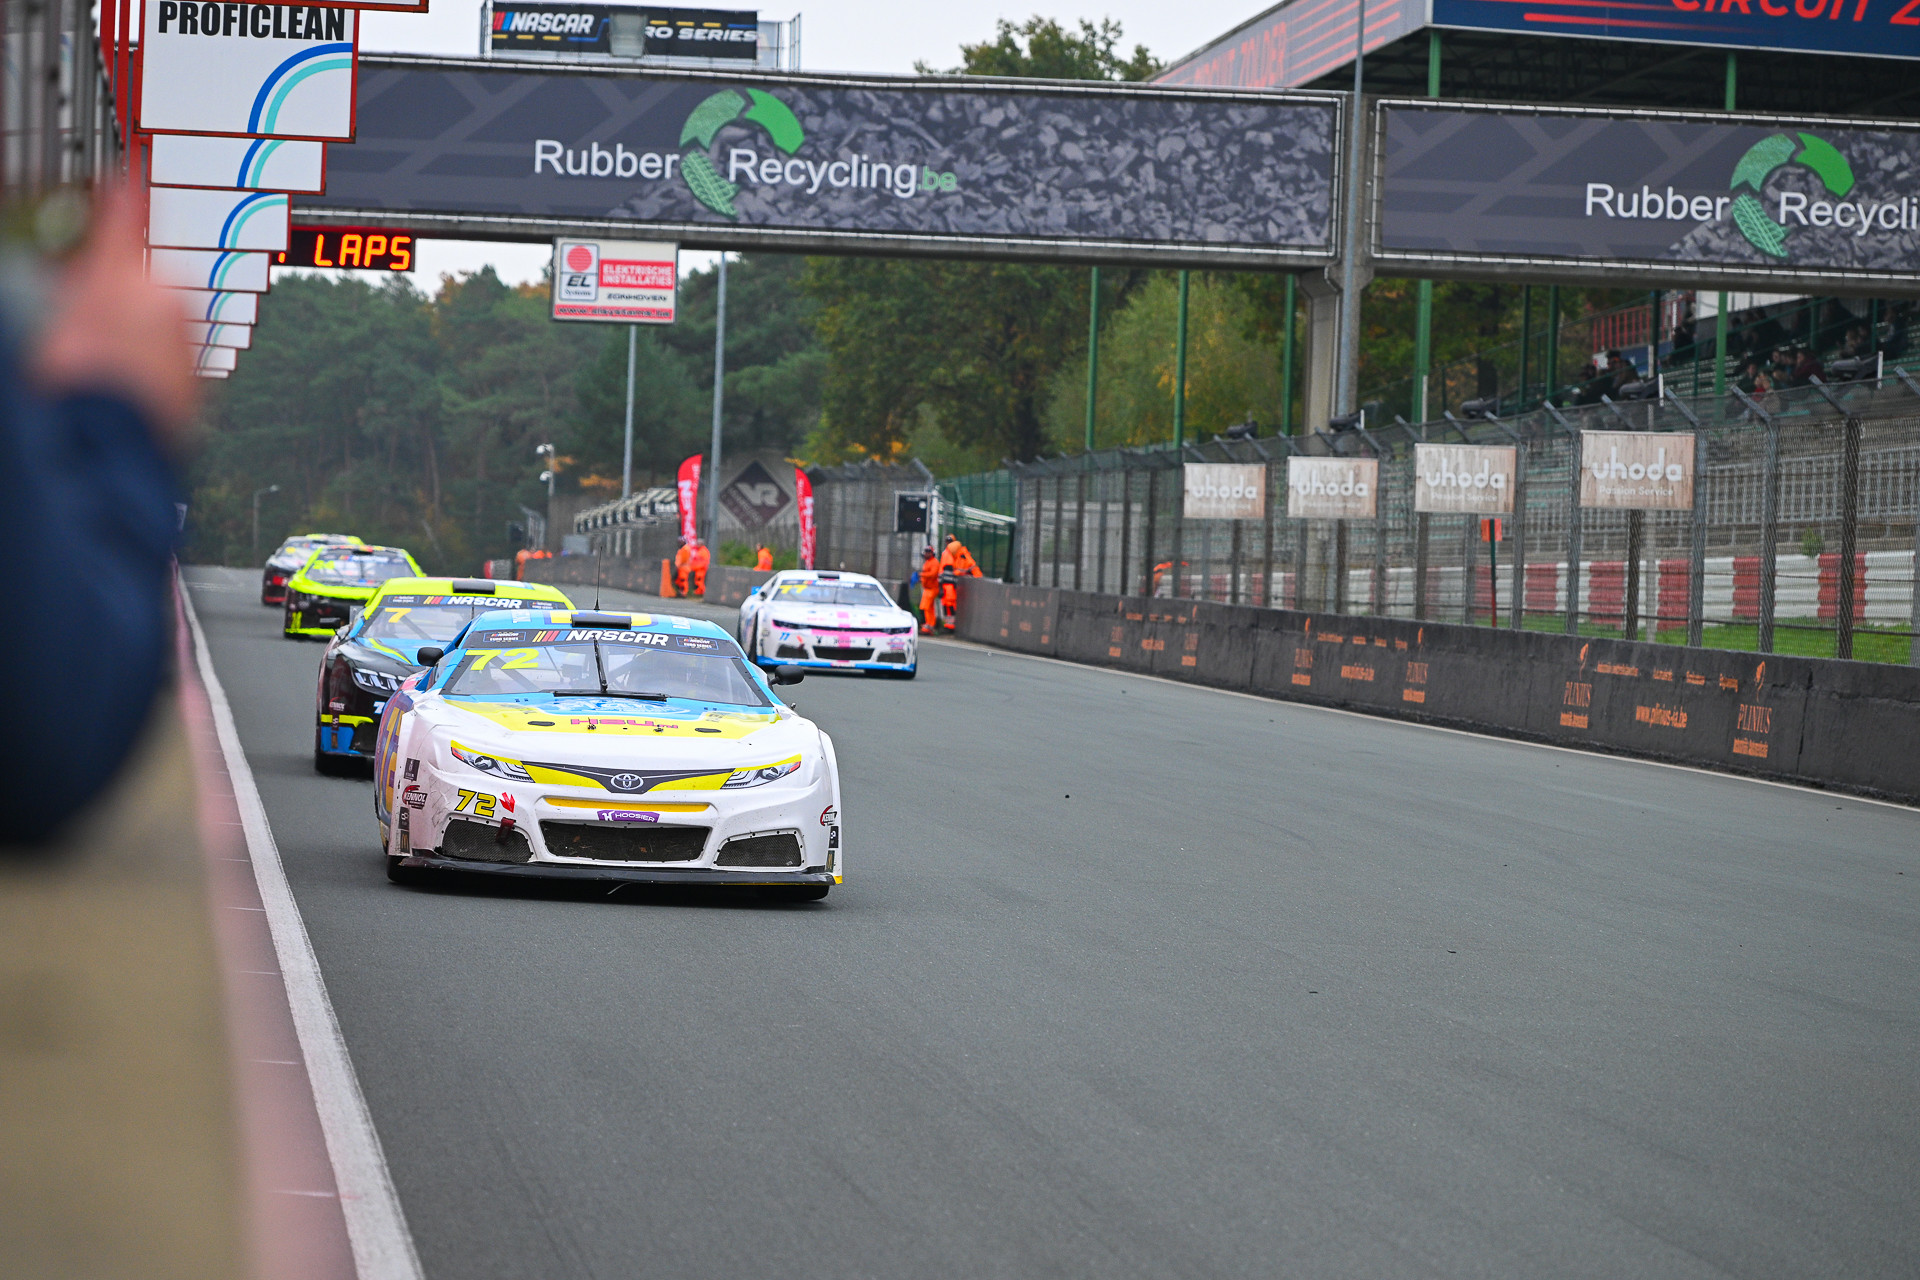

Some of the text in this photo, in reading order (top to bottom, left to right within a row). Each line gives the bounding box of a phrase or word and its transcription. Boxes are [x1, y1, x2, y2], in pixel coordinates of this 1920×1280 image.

[158, 1, 345, 41] PROFICLEAN
[509, 12, 595, 34] NASCAR
[678, 28, 758, 41] SERIES
[534, 139, 680, 179] Rubber
[1585, 182, 1730, 222] Rubber
[314, 233, 412, 270] LAPS
[602, 264, 672, 275] ELEKTRISCHE
[602, 275, 672, 285] INSTALLATIES
[567, 275, 591, 287] EL
[1426, 457, 1505, 488] uhoda
[1592, 446, 1683, 482] uhoda
[1192, 474, 1258, 499] uhoda
[1296, 470, 1369, 497] uhoda
[1599, 485, 1674, 498] Passion Service
[779, 585, 808, 594] 77
[448, 596, 522, 608] NASCAR
[384, 608, 412, 623] 7
[566, 629, 669, 646] NASCAR
[465, 648, 539, 671] 72
[1737, 703, 1773, 734] PLINIUS
[454, 788, 497, 818] 72
[615, 812, 656, 822] HOOSIER
